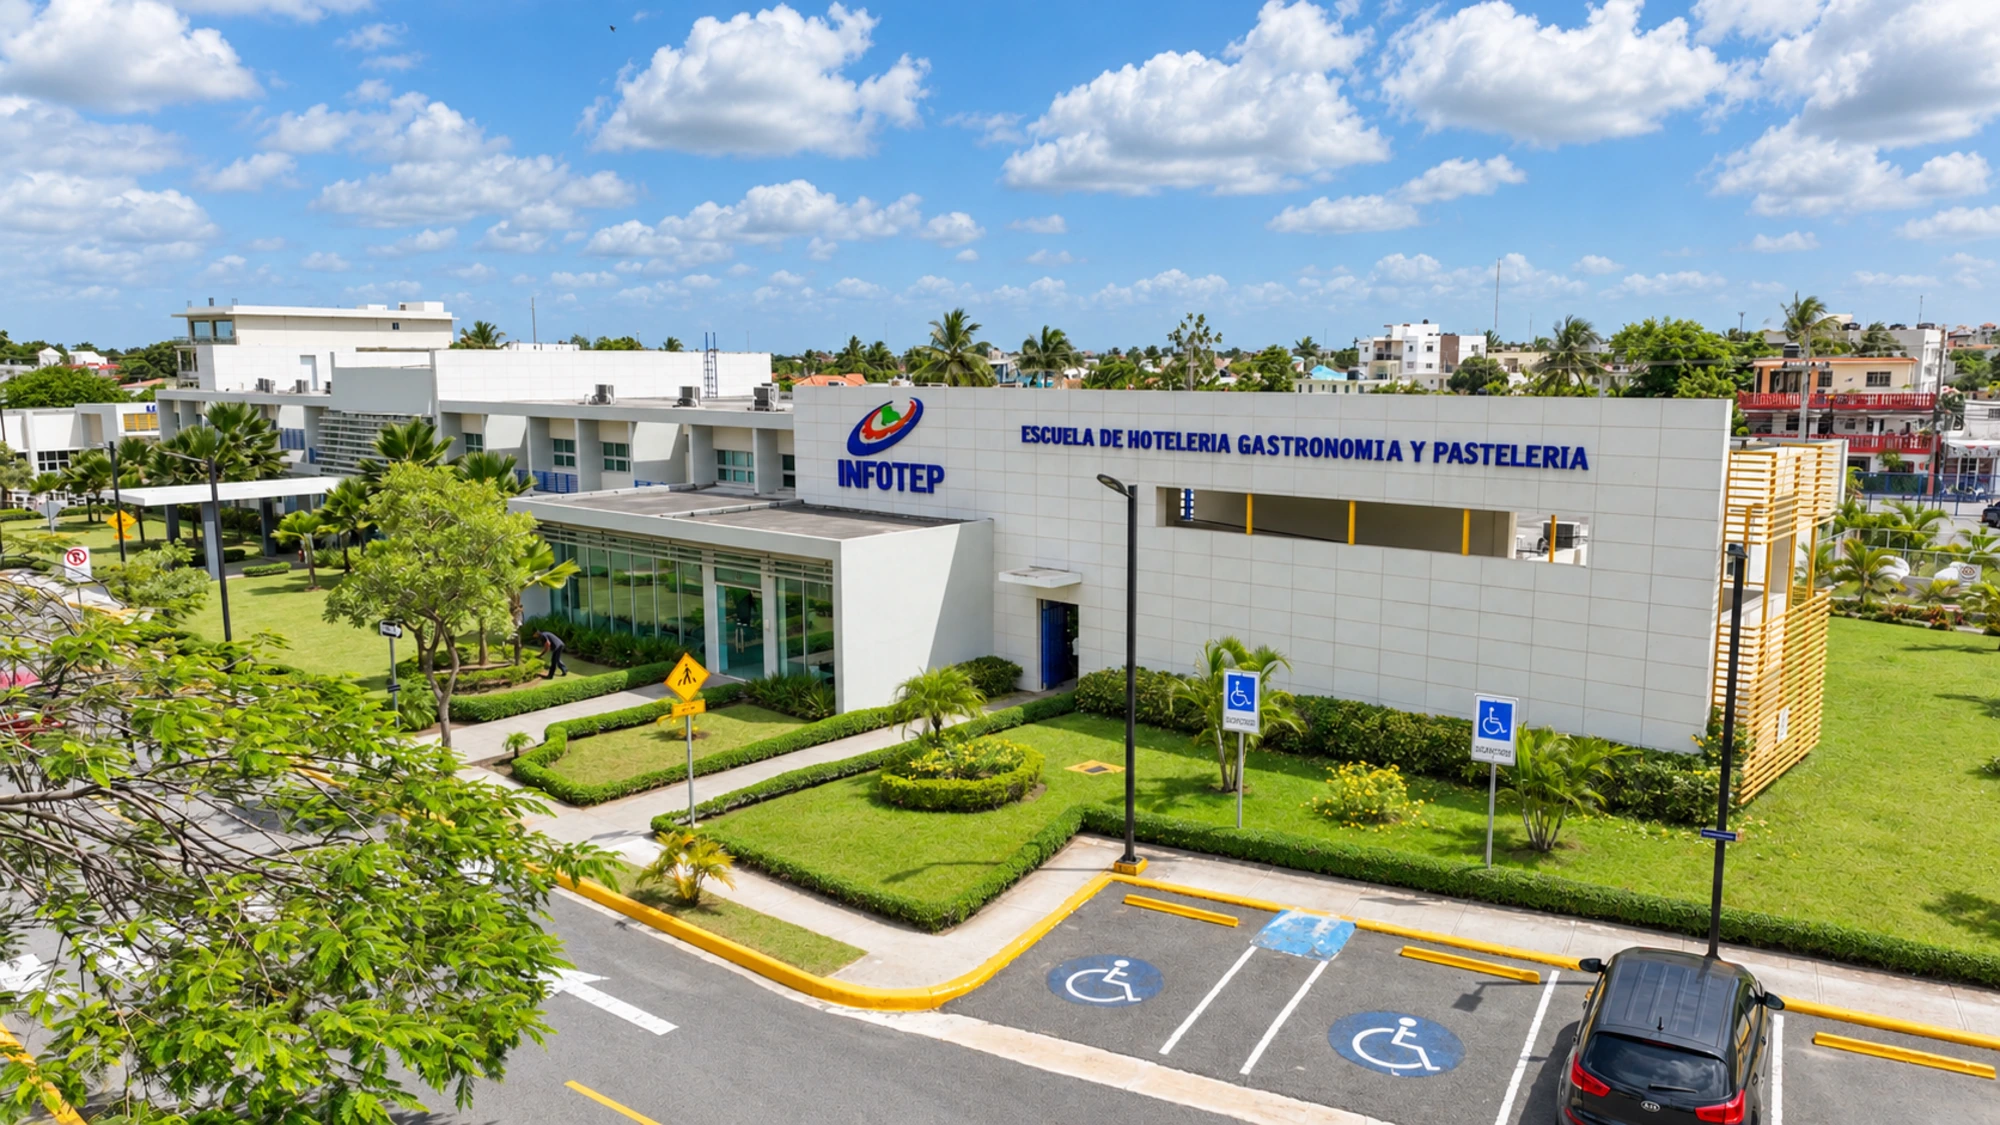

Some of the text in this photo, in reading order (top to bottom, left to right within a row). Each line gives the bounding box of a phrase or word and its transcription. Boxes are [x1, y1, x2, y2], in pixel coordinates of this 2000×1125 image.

[1021, 424, 1589, 470] ESCUELA DE HOTELERIA GASTRONOMIA Y PASTELERIA
[837, 458, 945, 494] INFOTEP
